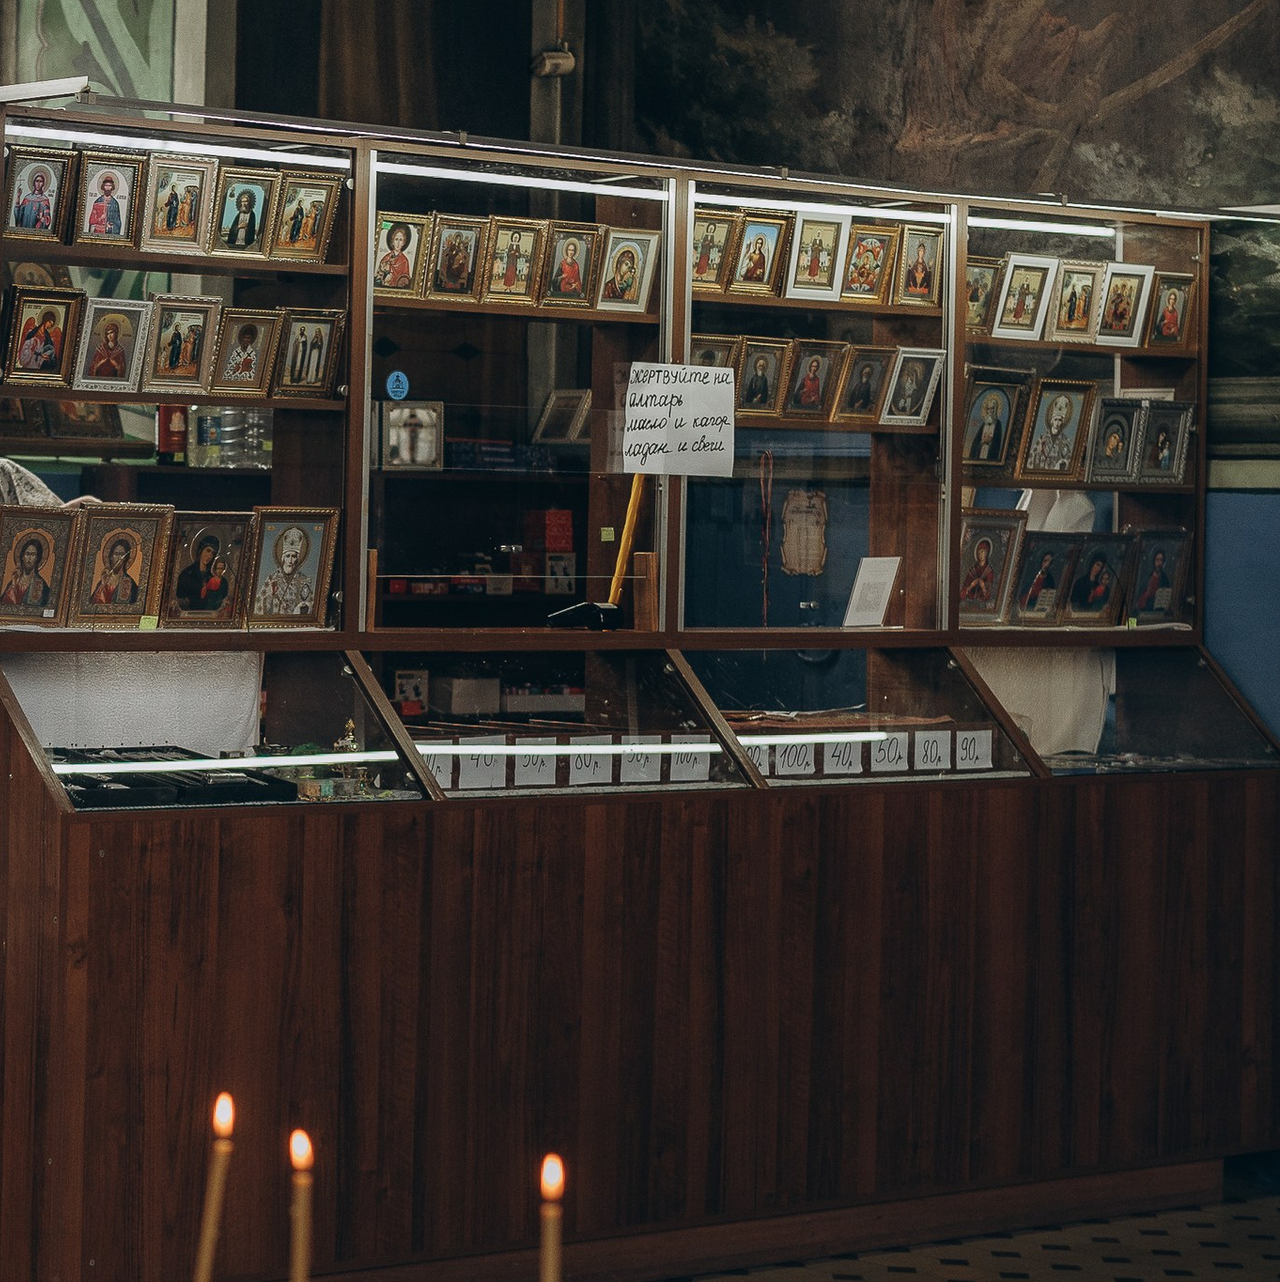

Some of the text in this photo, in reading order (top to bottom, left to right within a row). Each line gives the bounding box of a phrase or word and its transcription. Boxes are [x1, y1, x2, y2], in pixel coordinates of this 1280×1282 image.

[714, 371, 733, 385] на
[629, 392, 684, 417] алтарь
[627, 415, 731, 432] масло и кагор
[625, 435, 725, 466] ладан и свечи
